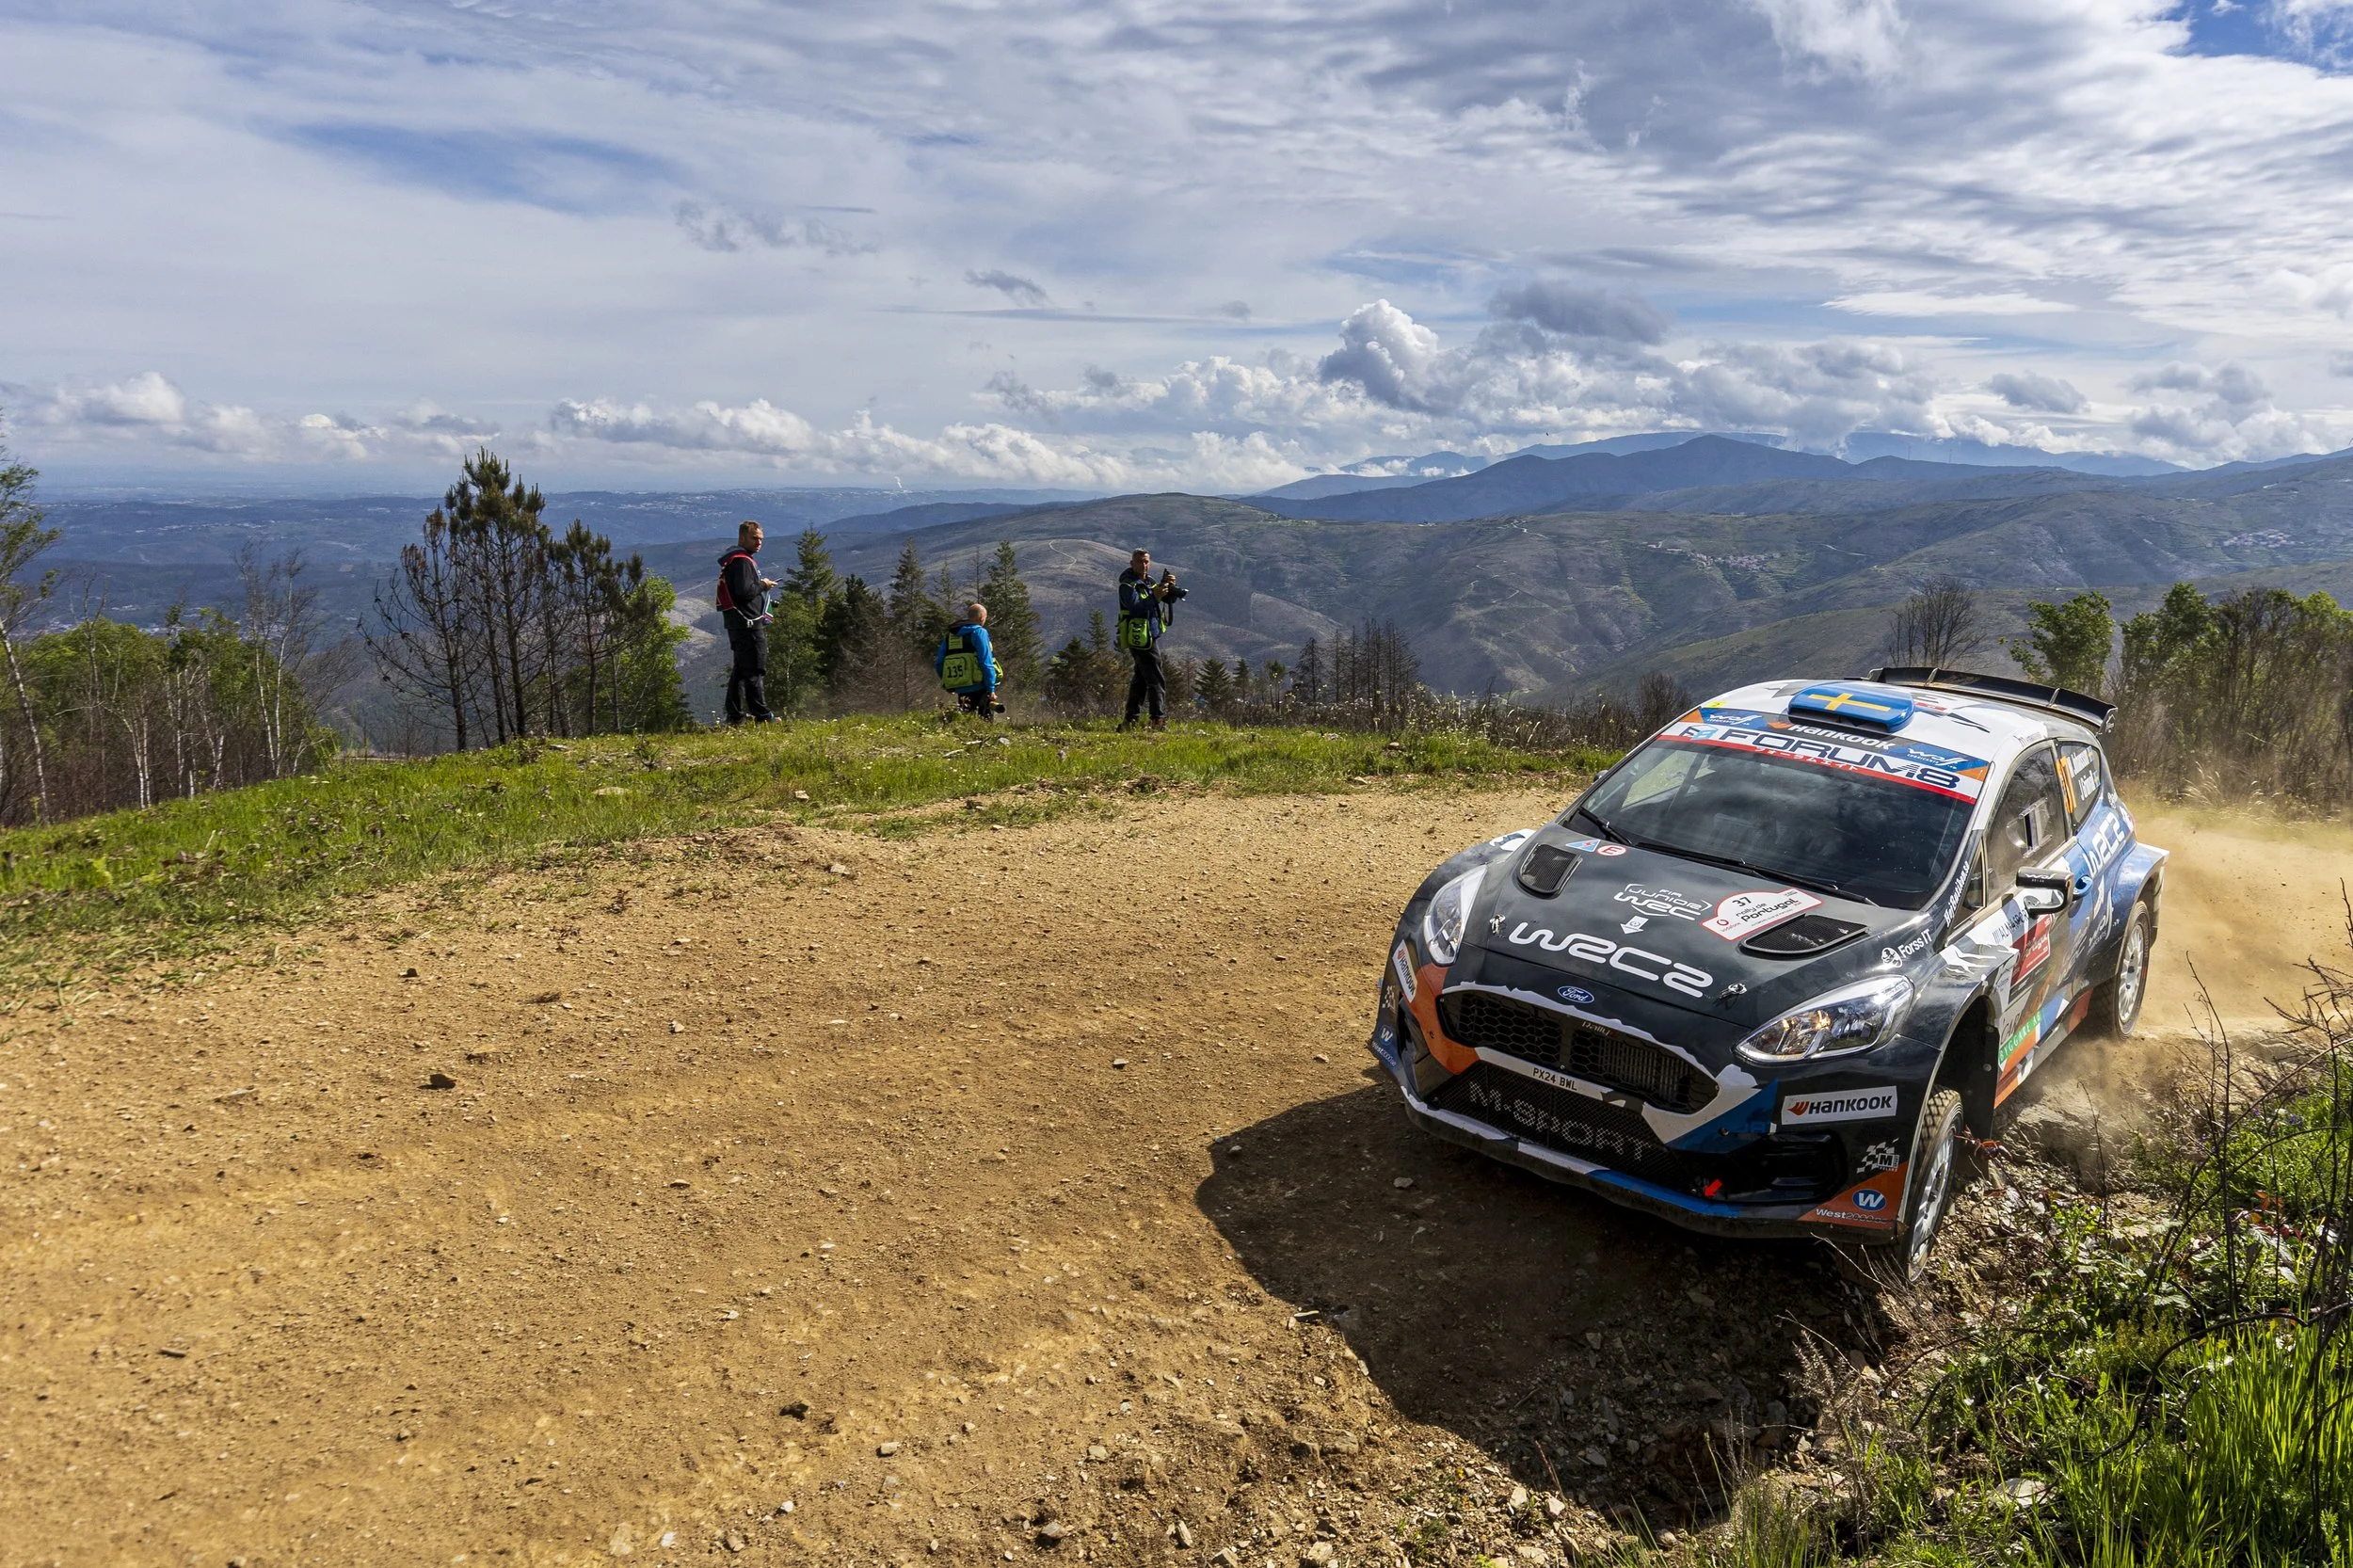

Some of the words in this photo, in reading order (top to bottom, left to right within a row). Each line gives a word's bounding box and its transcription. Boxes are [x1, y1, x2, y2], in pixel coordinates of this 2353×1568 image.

[947, 665, 964, 678] 135
[1719, 728, 1961, 789] FORUM8
[1602, 845, 1623, 856] E
[1628, 888, 1704, 910] JUNIOR
[1658, 888, 1682, 897] FIA
[1732, 896, 1753, 907] 37
[1613, 892, 1702, 921] WRC
[1736, 905, 1756, 917] rally
[1740, 898, 1799, 922] Portugal
[1897, 936, 1926, 958] Forss
[1922, 928, 1933, 945] IT
[1508, 921, 1714, 999] WRC2
[1561, 987, 1589, 1002] Ford
[1381, 1027, 1394, 1043] W
[1532, 1066, 1557, 1083] PX24
[1559, 1077, 1578, 1092] BWL
[1468, 1081, 1652, 1161] M-SPORT
[1858, 1192, 1885, 1208] W
